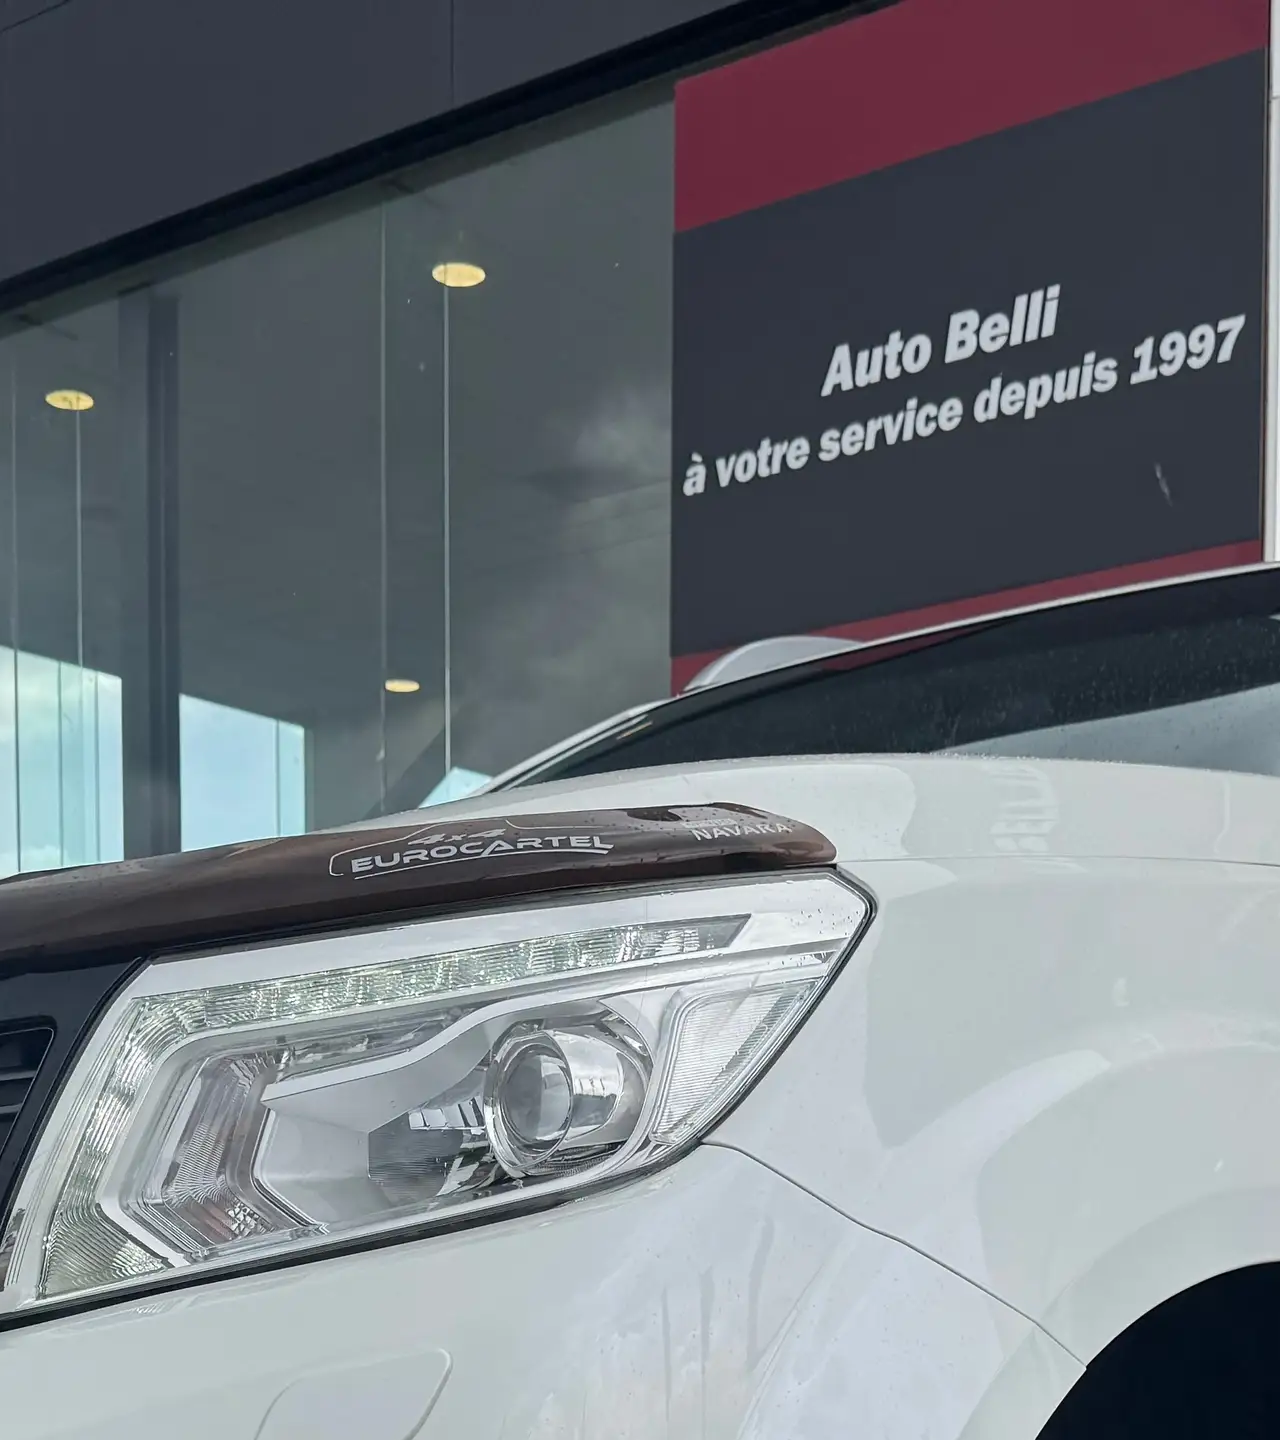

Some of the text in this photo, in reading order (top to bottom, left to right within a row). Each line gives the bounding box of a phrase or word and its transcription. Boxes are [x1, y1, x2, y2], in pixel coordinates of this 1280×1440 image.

[821, 284, 1061, 396] Auto Belli
[682, 314, 1246, 497] à votre service depuis 1997
[350, 834, 615, 875] EUROCARTEL
[691, 821, 793, 841] NAVARA
